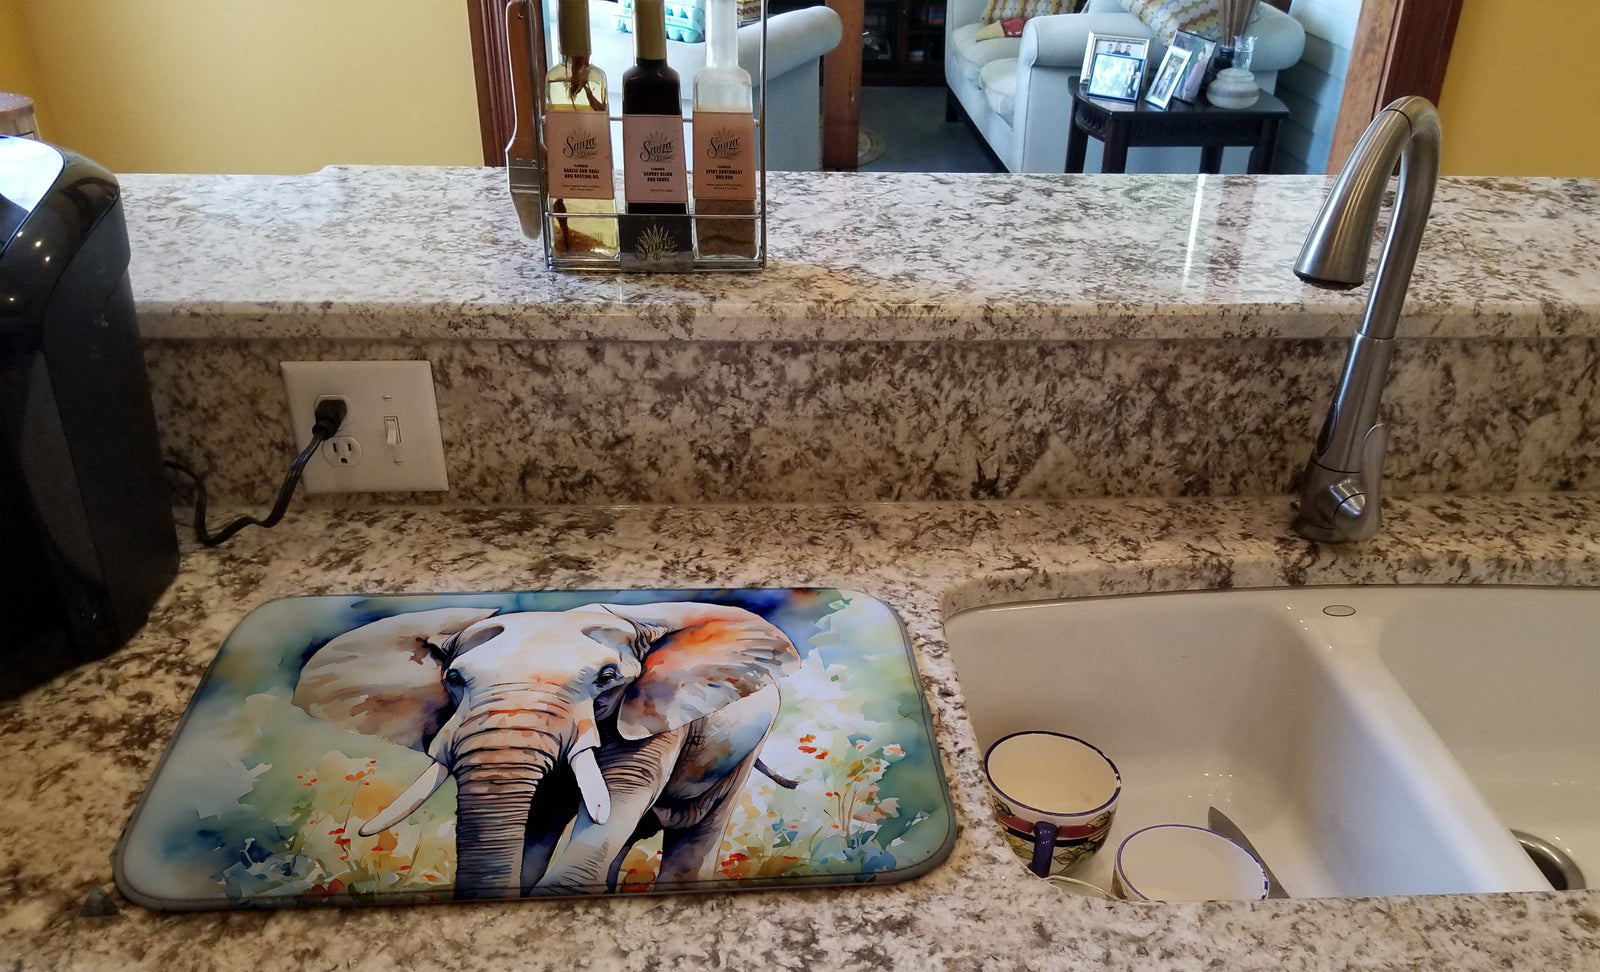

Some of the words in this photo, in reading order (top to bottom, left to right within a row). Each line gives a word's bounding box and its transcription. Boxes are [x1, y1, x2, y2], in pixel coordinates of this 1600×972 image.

[563, 136, 597, 158] Sauza
[640, 140, 674, 162] Sauza
[707, 136, 741, 159] Sauza
